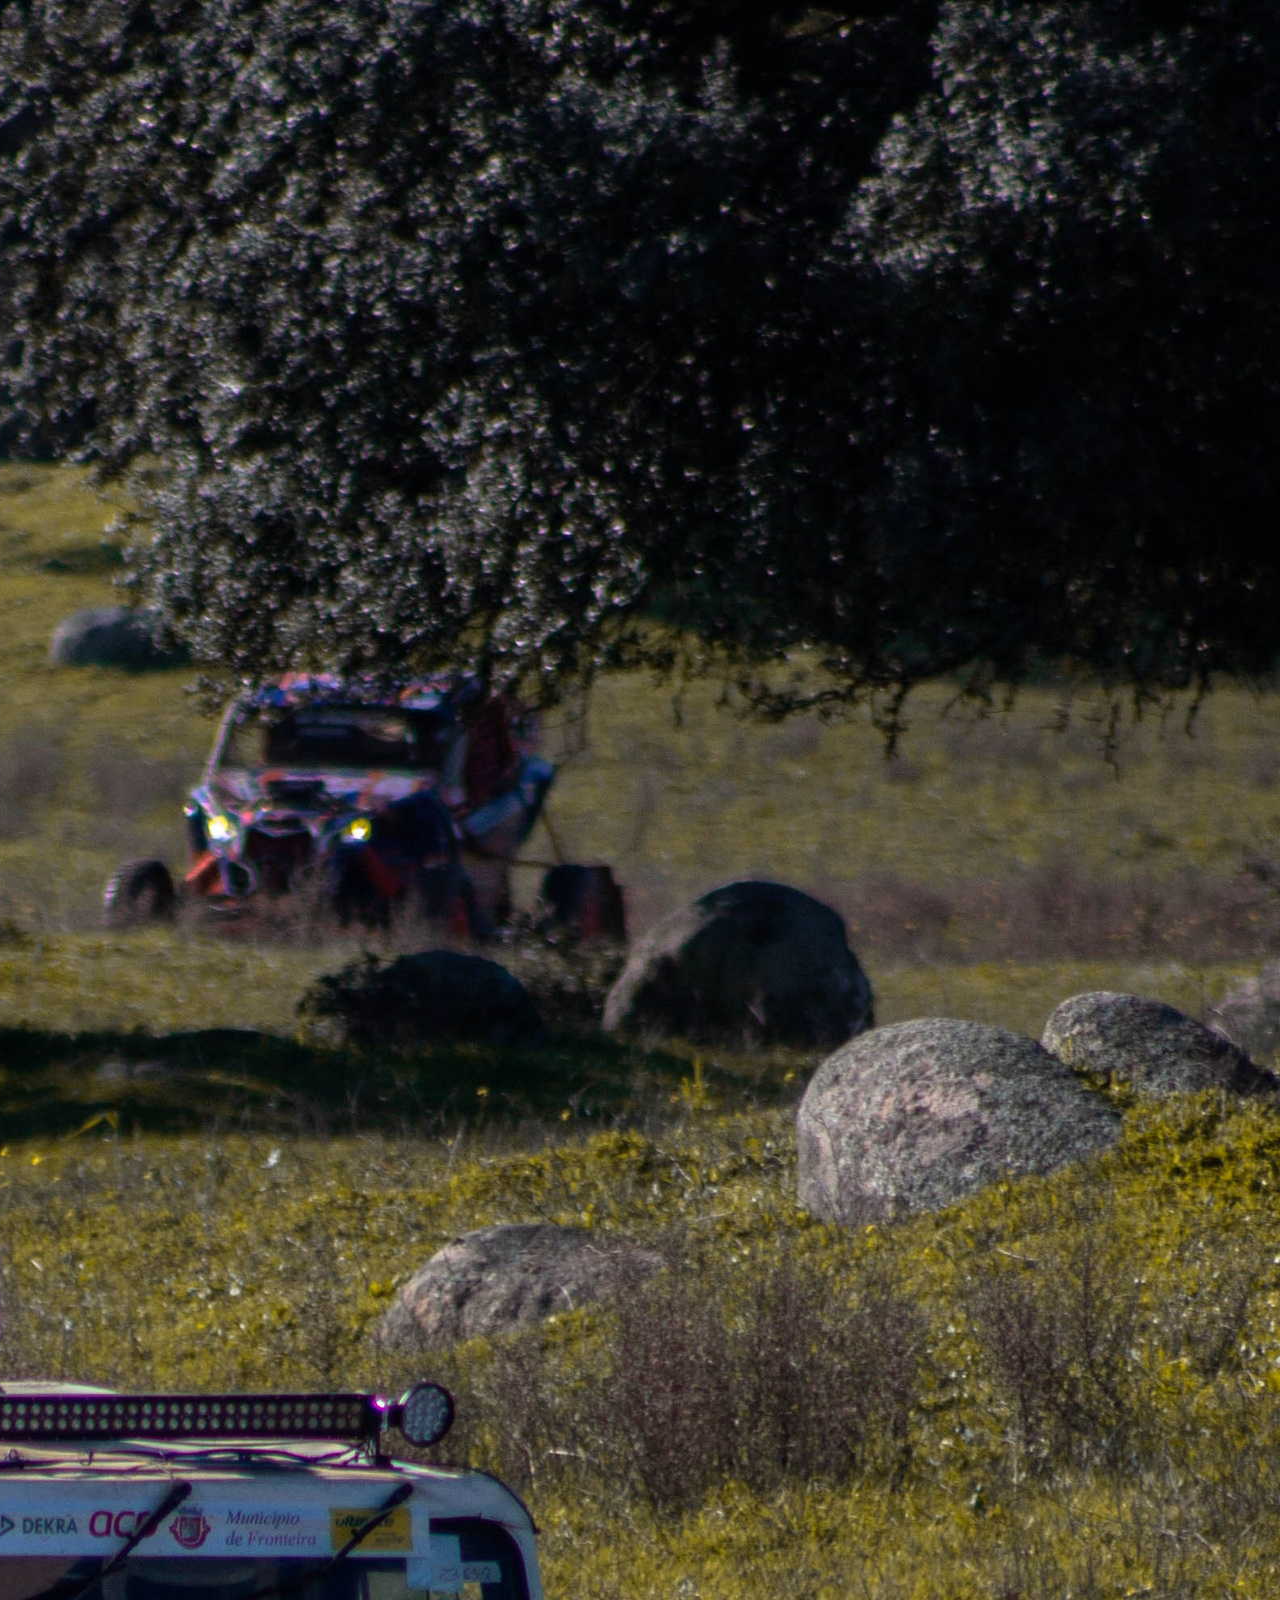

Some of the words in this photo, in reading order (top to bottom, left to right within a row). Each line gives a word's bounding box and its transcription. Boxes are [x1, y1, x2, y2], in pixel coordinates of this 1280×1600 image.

[22, 1517, 78, 1534] DEKRA
[225, 1530, 243, 1546] de
[248, 1530, 317, 1546] Fronteira
